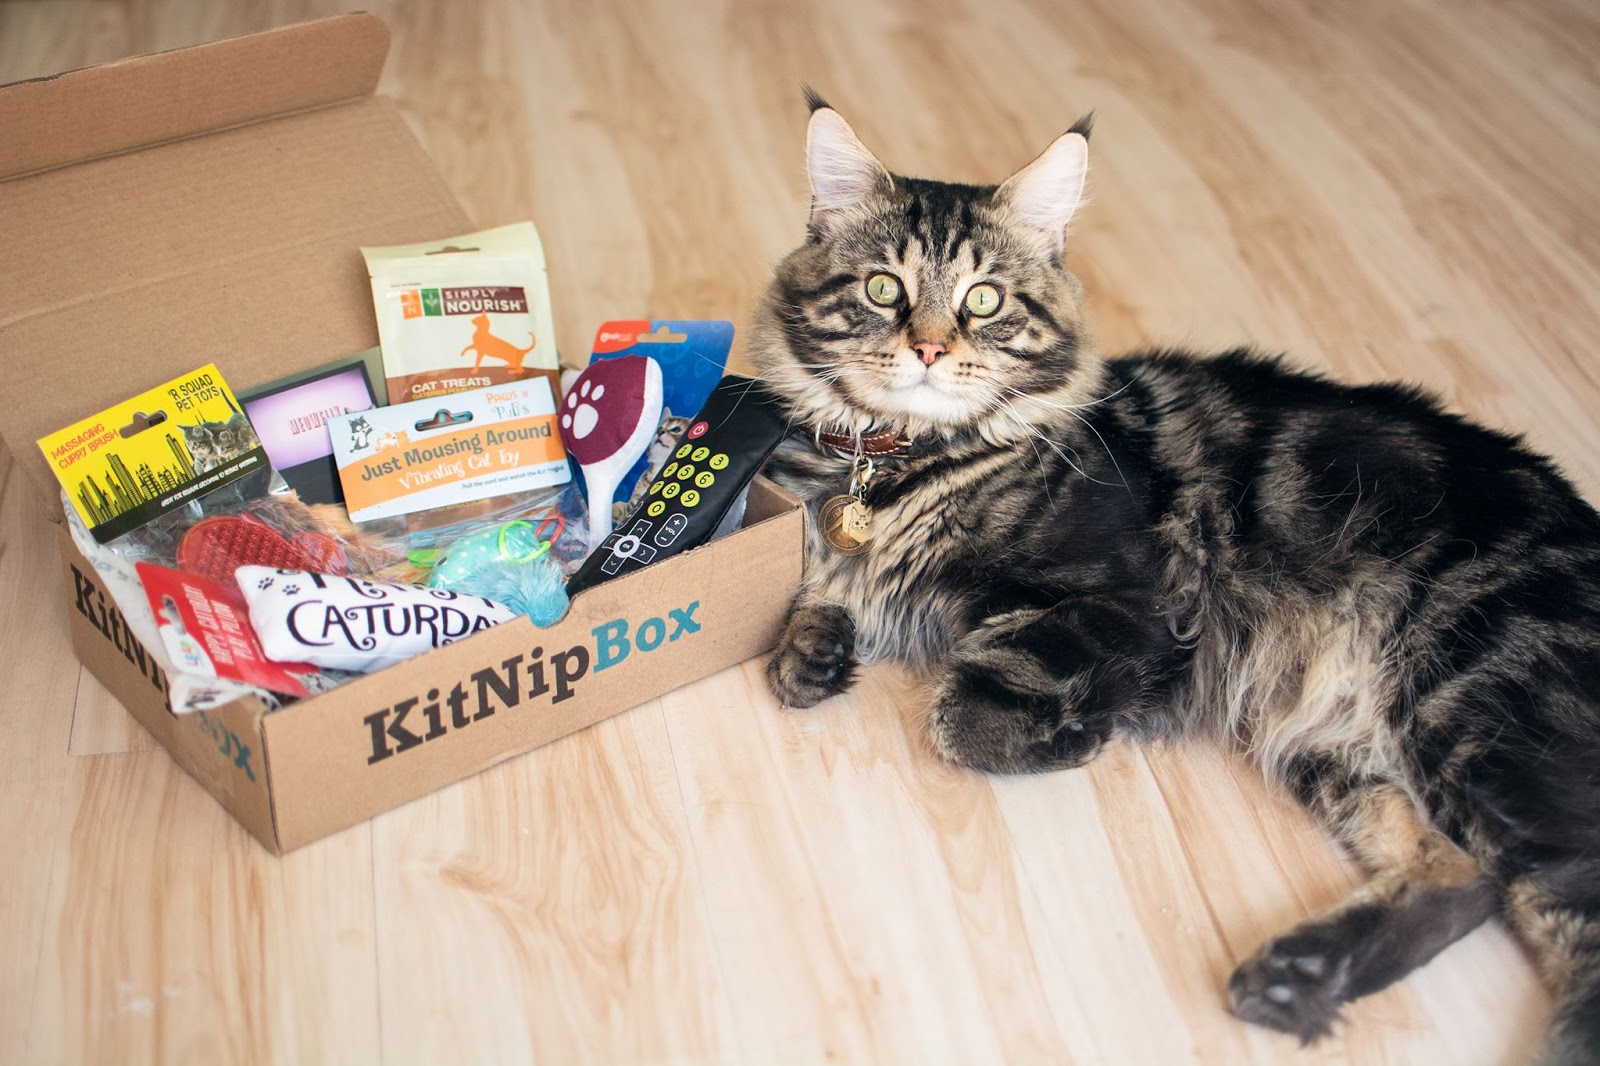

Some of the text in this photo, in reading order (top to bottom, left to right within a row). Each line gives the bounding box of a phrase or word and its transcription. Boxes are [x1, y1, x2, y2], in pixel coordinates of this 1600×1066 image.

[445, 289, 497, 300] SIMPLY
[447, 300, 522, 313] NOURISH
[179, 373, 213, 397] SQUAD
[411, 377, 492, 394] CAT TREATS
[175, 386, 220, 413] PET TOYS
[50, 423, 105, 460] MASSAGING
[89, 428, 120, 455] BRUSH
[360, 421, 552, 482] Just Mousing Around
[398, 449, 521, 490] Vibrating Cat Toy
[665, 525, 677, 536] VOL
[286, 600, 500, 652] CATURDA
[363, 600, 702, 766] KitNipBox
